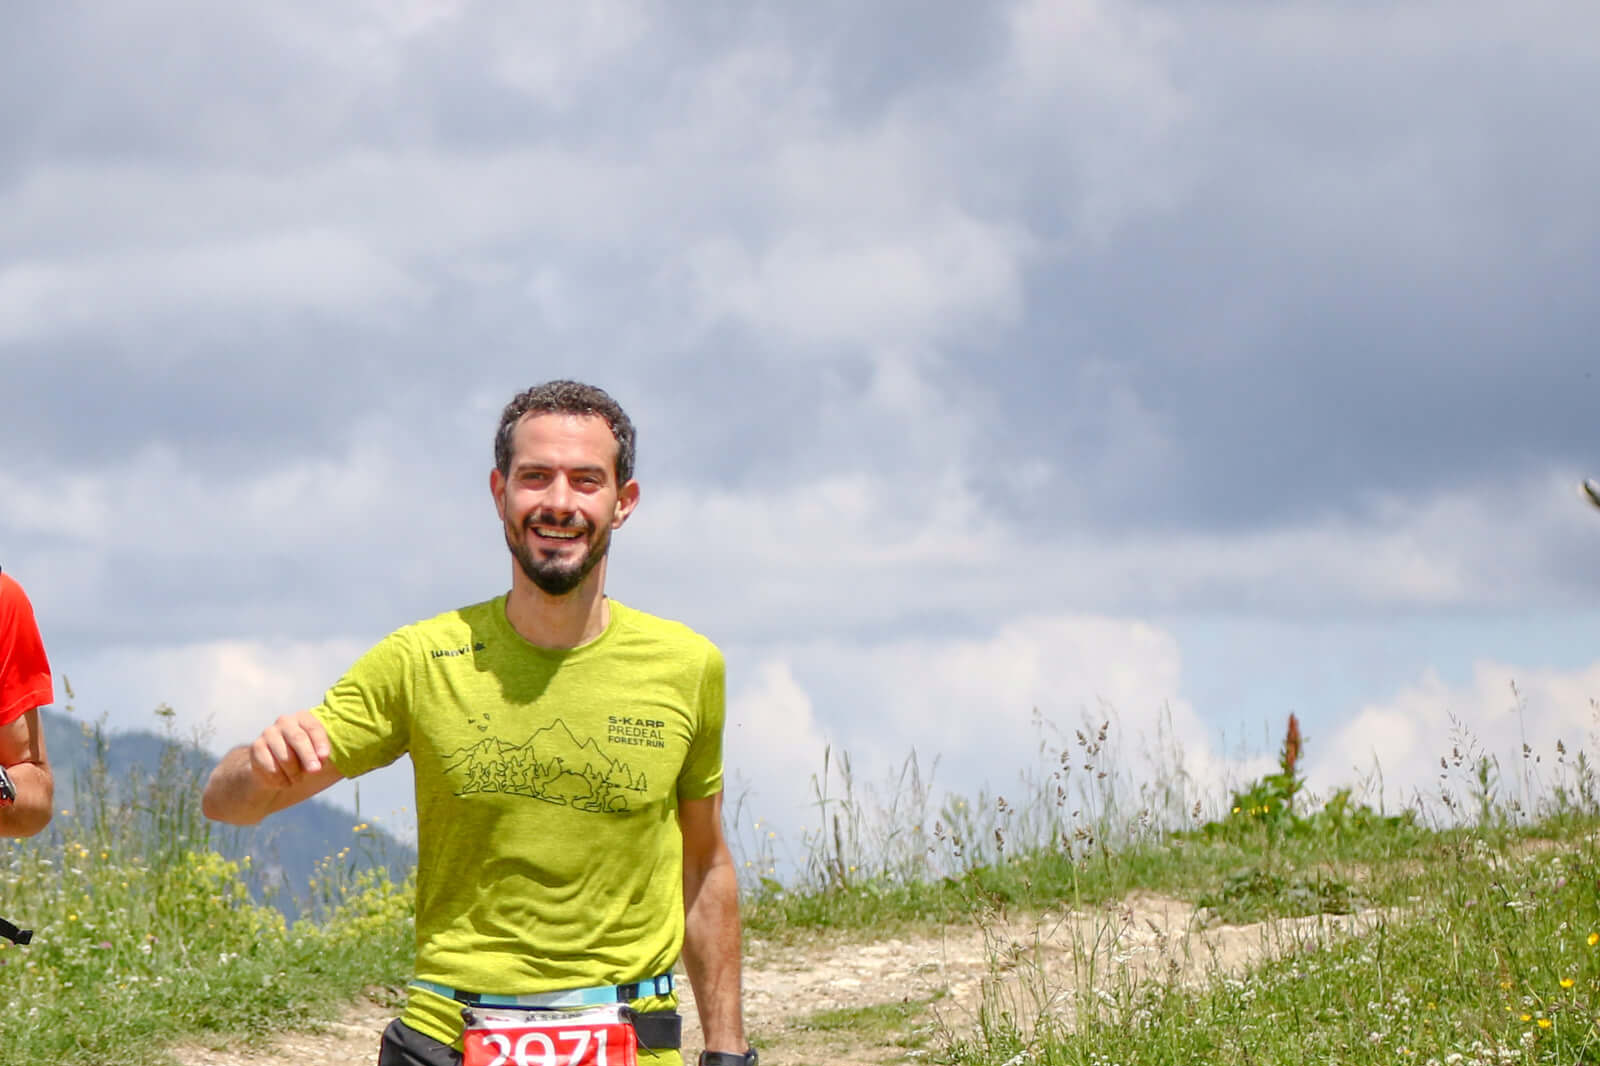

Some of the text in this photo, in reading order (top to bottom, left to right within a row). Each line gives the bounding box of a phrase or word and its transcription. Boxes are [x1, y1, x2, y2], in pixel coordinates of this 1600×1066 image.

[608, 725, 665, 740] PREDEAL
[608, 735, 665, 749] FOREST RUN
